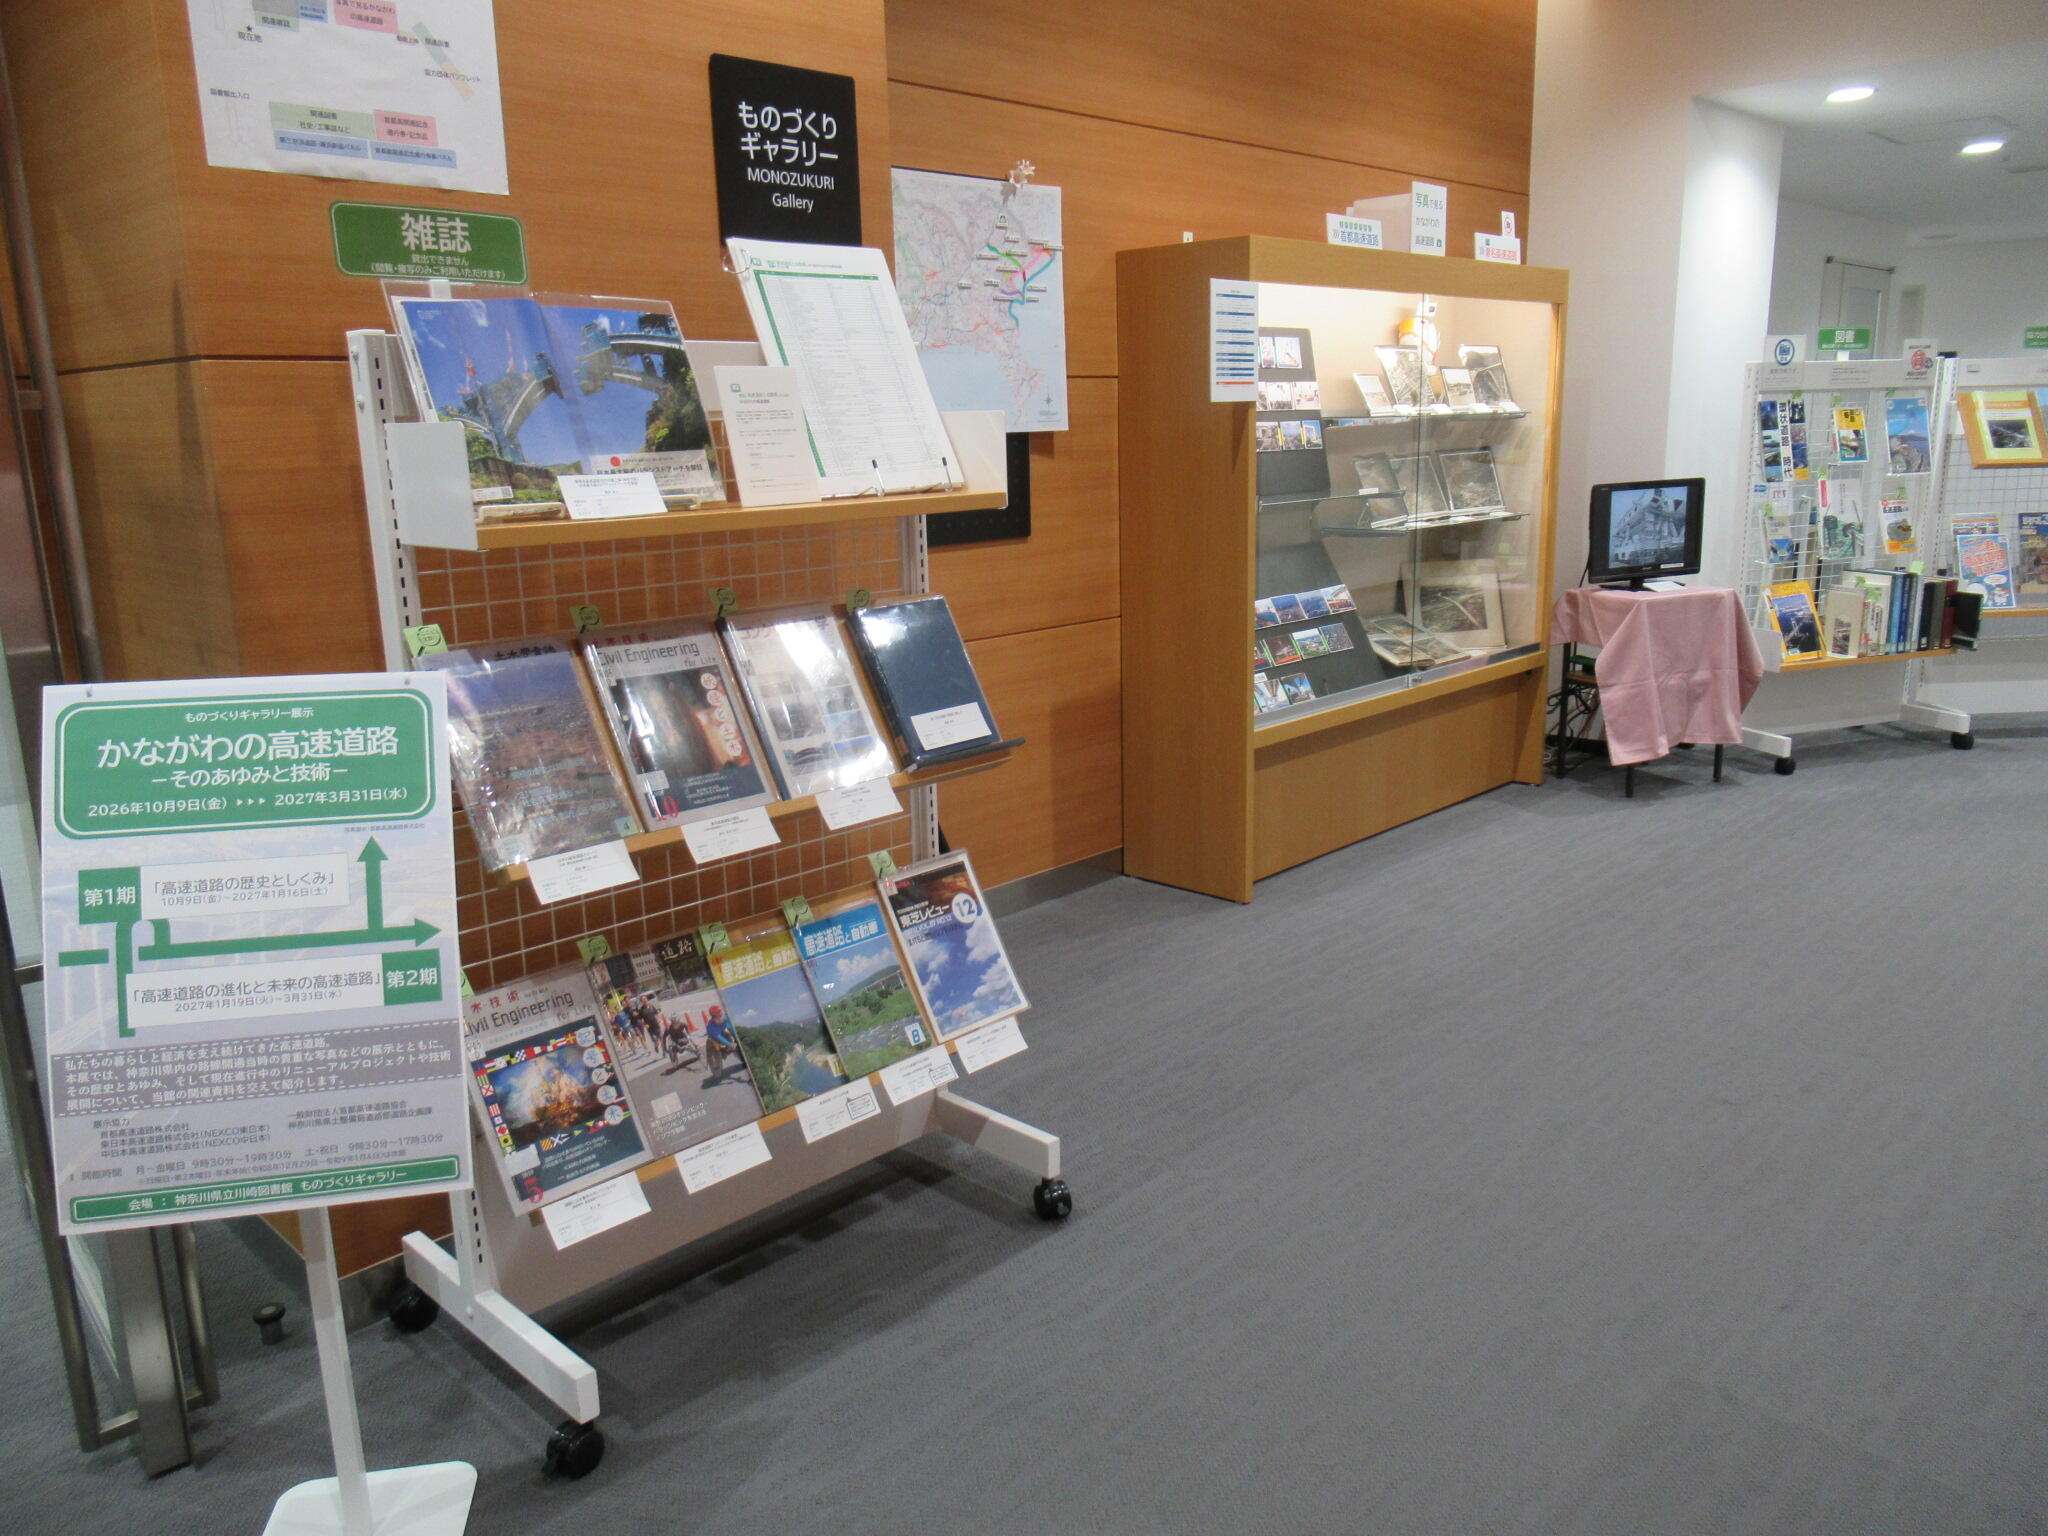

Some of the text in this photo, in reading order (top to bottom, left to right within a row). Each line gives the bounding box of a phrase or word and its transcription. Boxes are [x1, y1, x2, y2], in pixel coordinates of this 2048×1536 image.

[238, 31, 263, 43] 現在地
[738, 101, 837, 140] ものづくり
[740, 132, 839, 168] ギャラリー
[747, 166, 835, 191] MONOZUKURI
[771, 192, 814, 213] Gallery
[1415, 192, 1443, 210] 写真で見る
[400, 212, 472, 253] 雑誌
[411, 254, 469, 266] 貸出できません
[597, 642, 700, 666] Civil Engineering
[184, 707, 315, 723] ものづくりギャラリー展示
[97, 725, 399, 769] かながわの高速道路
[88, 786, 409, 817] 2026年10月9日(金) 2027年3月31日(水)
[83, 884, 137, 908] 第1期
[152, 872, 336, 896] 「高速道路の歴史としくみ」
[899, 904, 950, 929] 東芝レビュー
[956, 898, 976, 917] 12
[803, 920, 879, 956] 高速道路と自動車
[386, 966, 439, 990] 第2期
[491, 992, 574, 1027] Engineering
[128, 1197, 153, 1211] 会場
[174, 1182, 294, 1206] 神奈川県立川崎図書館
[300, 1169, 408, 1191] ものづくりギャラリー
[523, 1176, 543, 1203] 5
